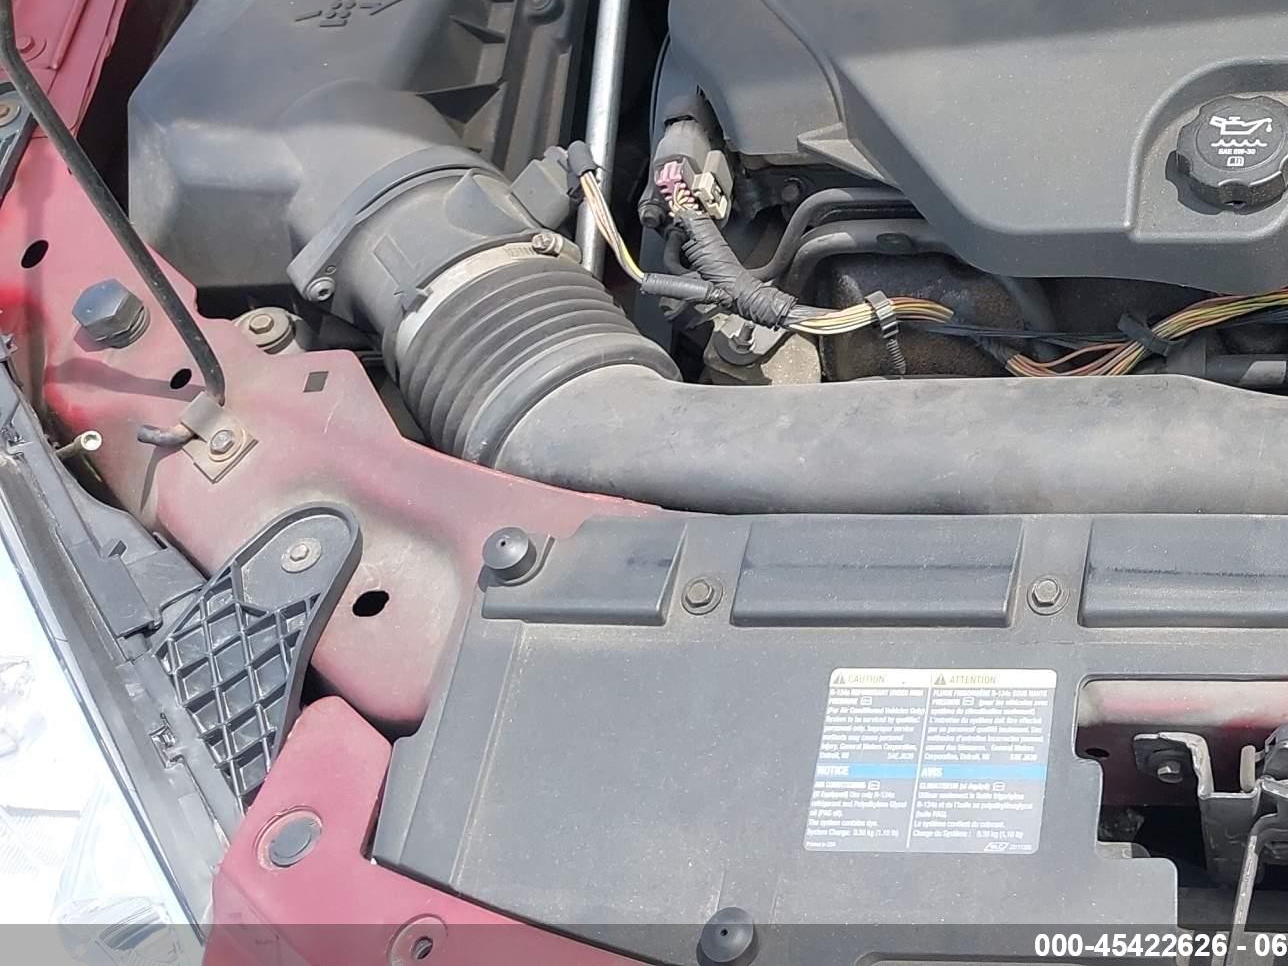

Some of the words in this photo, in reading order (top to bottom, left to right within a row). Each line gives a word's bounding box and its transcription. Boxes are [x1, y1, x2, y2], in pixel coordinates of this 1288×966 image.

[848, 675, 885, 683] CAUTION
[949, 675, 996, 684] ATTENTION
[816, 766, 849, 775] NOTICE
[921, 768, 943, 777] AVIS
